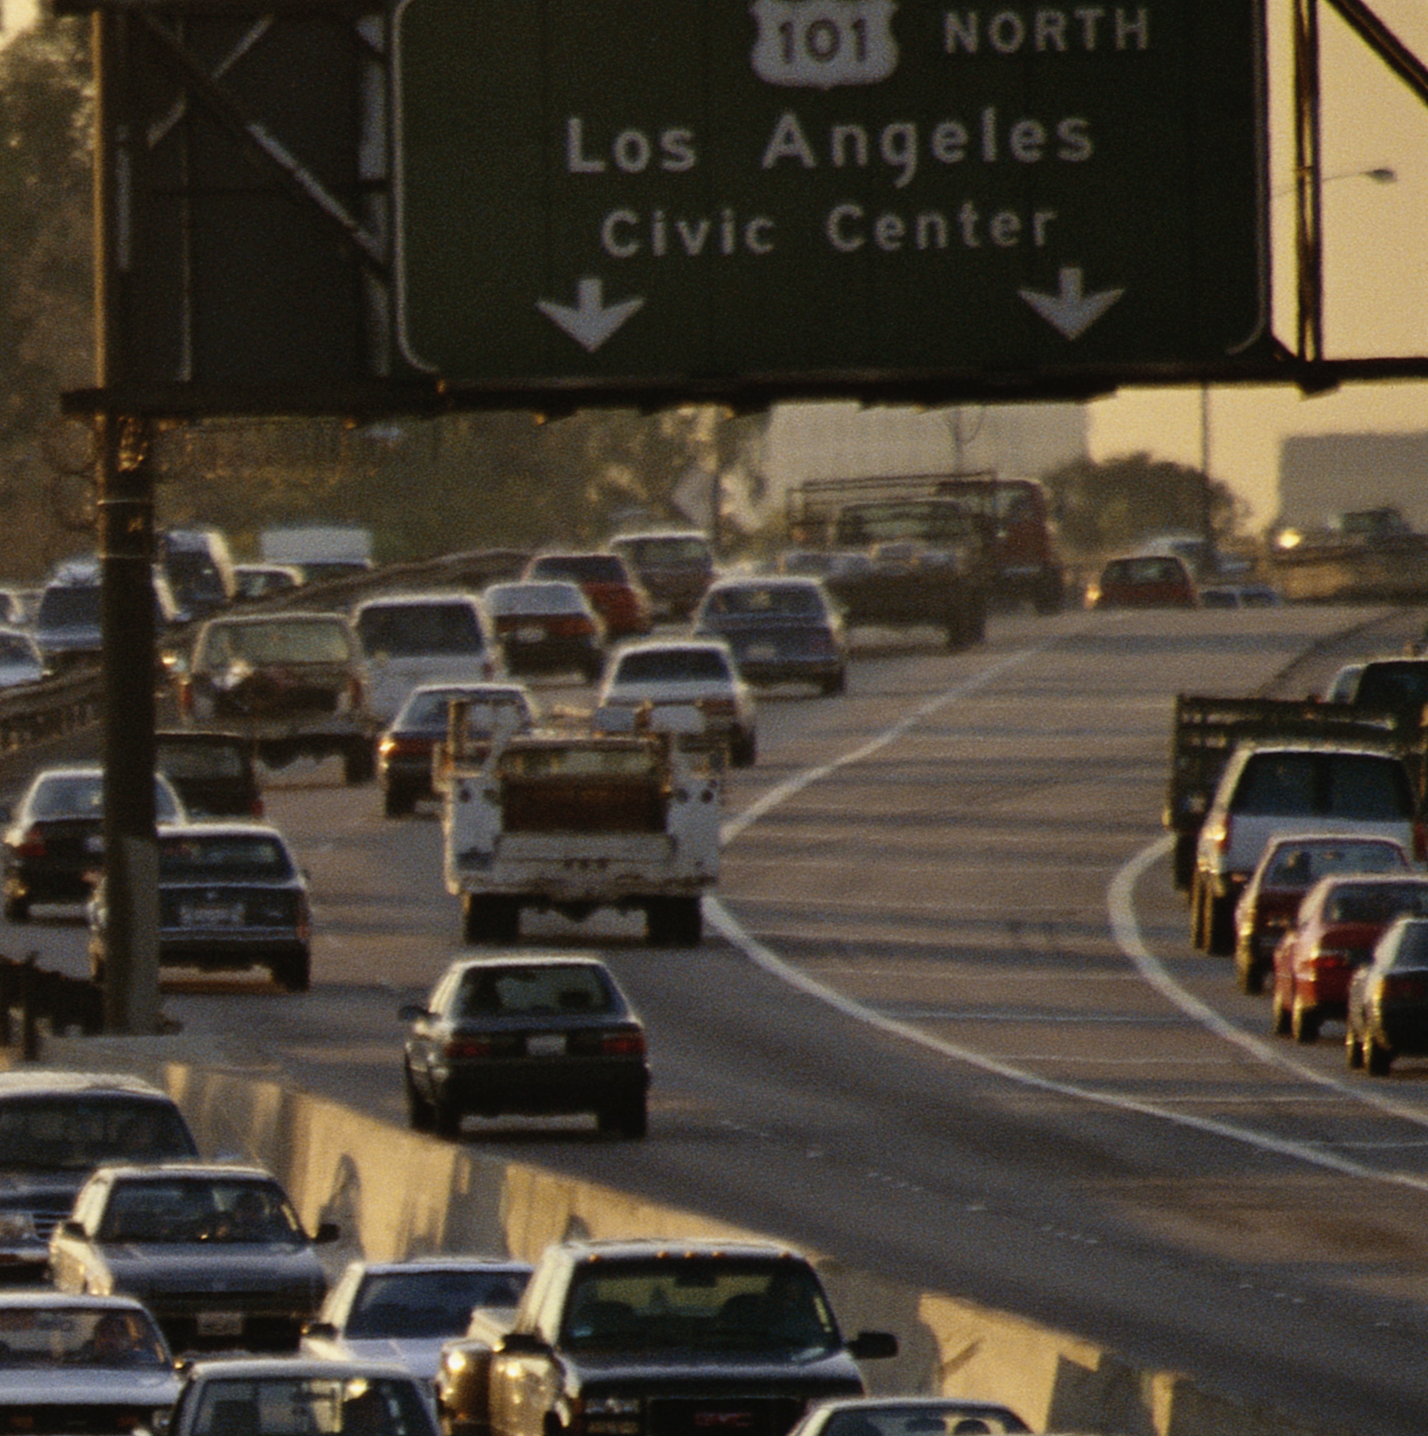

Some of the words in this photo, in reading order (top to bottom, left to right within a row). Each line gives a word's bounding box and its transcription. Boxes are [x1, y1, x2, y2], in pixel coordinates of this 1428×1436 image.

[777, 17, 868, 65] 101
[944, 8, 1149, 54] NORTH
[566, 115, 698, 173] Los
[761, 106, 1094, 189] Angeles
[600, 207, 776, 259] Civic
[825, 202, 1058, 252] Center
